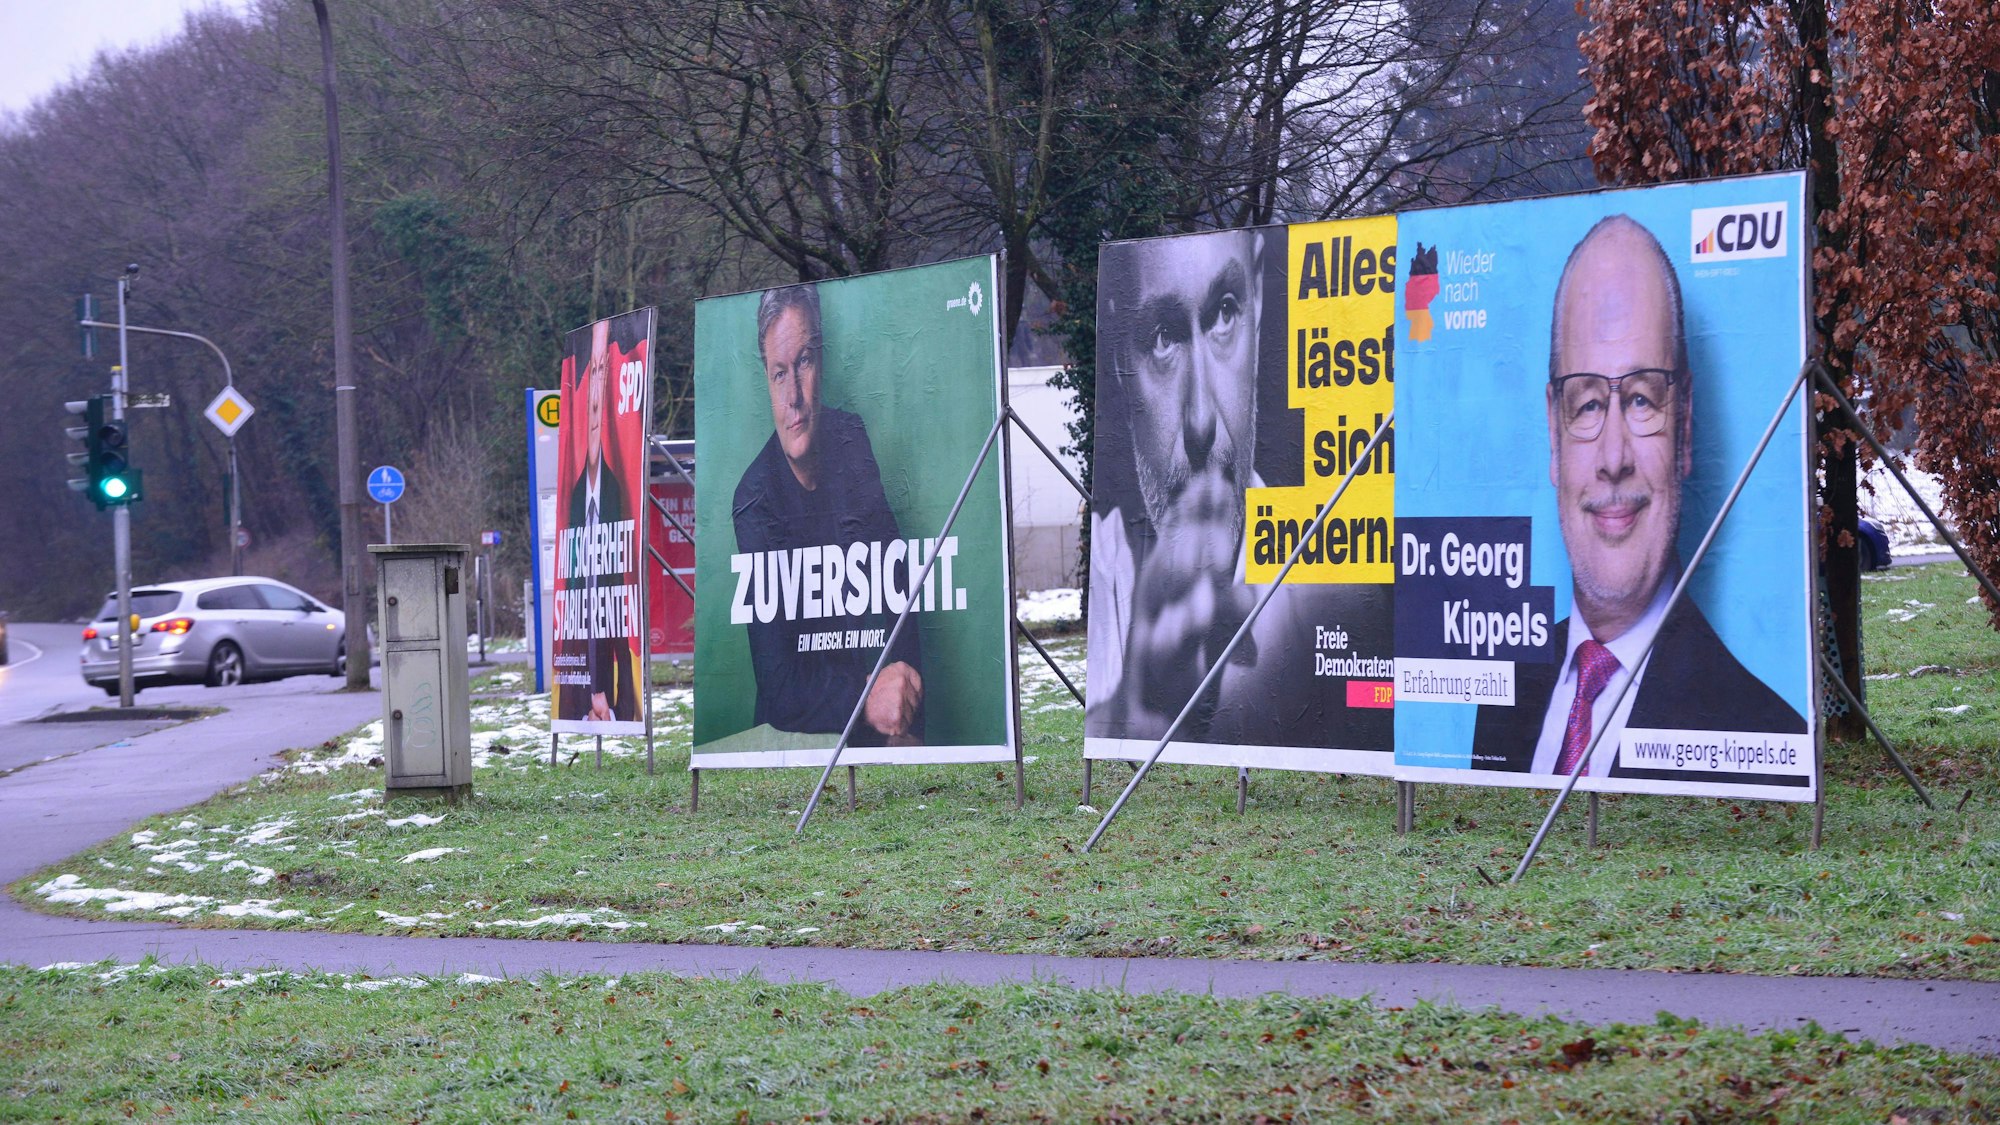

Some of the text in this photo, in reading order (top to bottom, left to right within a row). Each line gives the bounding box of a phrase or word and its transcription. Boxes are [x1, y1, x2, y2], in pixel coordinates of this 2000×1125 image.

[1717, 211, 1783, 252] CDU
[1298, 235, 1397, 300] Alles
[1446, 249, 1496, 275] Wieder
[1444, 278, 1479, 303] nach
[1444, 309, 1487, 330] vorne
[1297, 323, 1395, 389] lässt
[618, 361, 643, 415] SPD
[1313, 413, 1395, 477] sich
[557, 519, 635, 579] MIT SICHERHEIT
[1402, 532, 1524, 588] Dr. Georg
[730, 536, 967, 625] ZUVERSICHT.
[554, 584, 639, 641] STABILE RENTEN
[1443, 599, 1549, 657] Kippels
[798, 629, 886, 652] EIN MENSCH. EIN WORT.
[1315, 625, 1348, 649] Freie
[1315, 651, 1395, 678] Demokraten
[1374, 686, 1393, 703] FDP
[1403, 669, 1508, 702] Erfahrung zählt
[1635, 738, 1797, 770] www.georg-kippels.de
